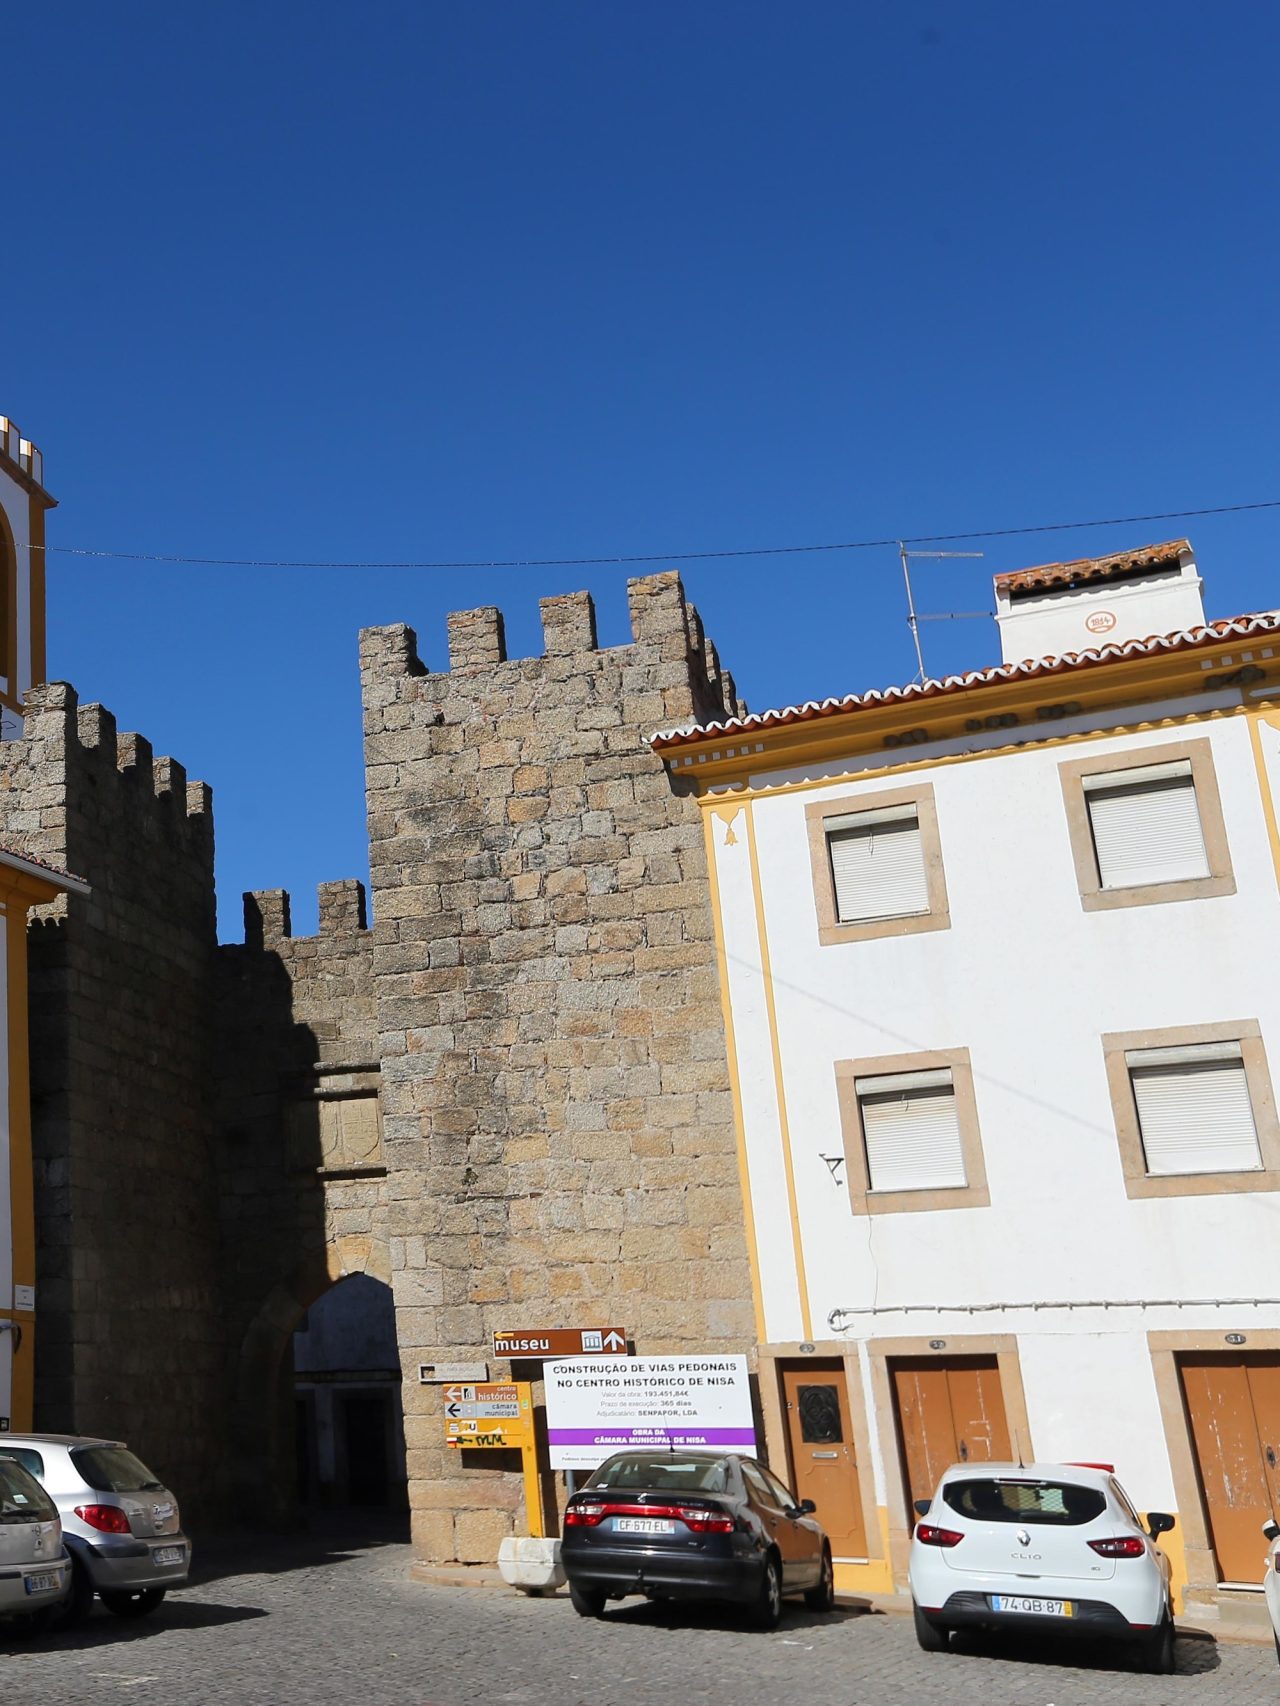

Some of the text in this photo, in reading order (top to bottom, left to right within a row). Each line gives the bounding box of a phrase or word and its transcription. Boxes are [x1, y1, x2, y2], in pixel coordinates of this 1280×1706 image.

[494, 1338, 550, 1351] museu
[553, 1362, 737, 1375] CONSTRUÇÃO DE VIAS PEDONAIS
[557, 1377, 735, 1388] NO CENTRO HISTÓRICO DE NISA
[478, 1392, 517, 1401] histórico
[644, 1390, 689, 1398] 193.451,84€
[593, 1436, 707, 1444] CÂMARA MUNICIPAL DE NISA
[1010, 1551, 1042, 1560] CLIO
